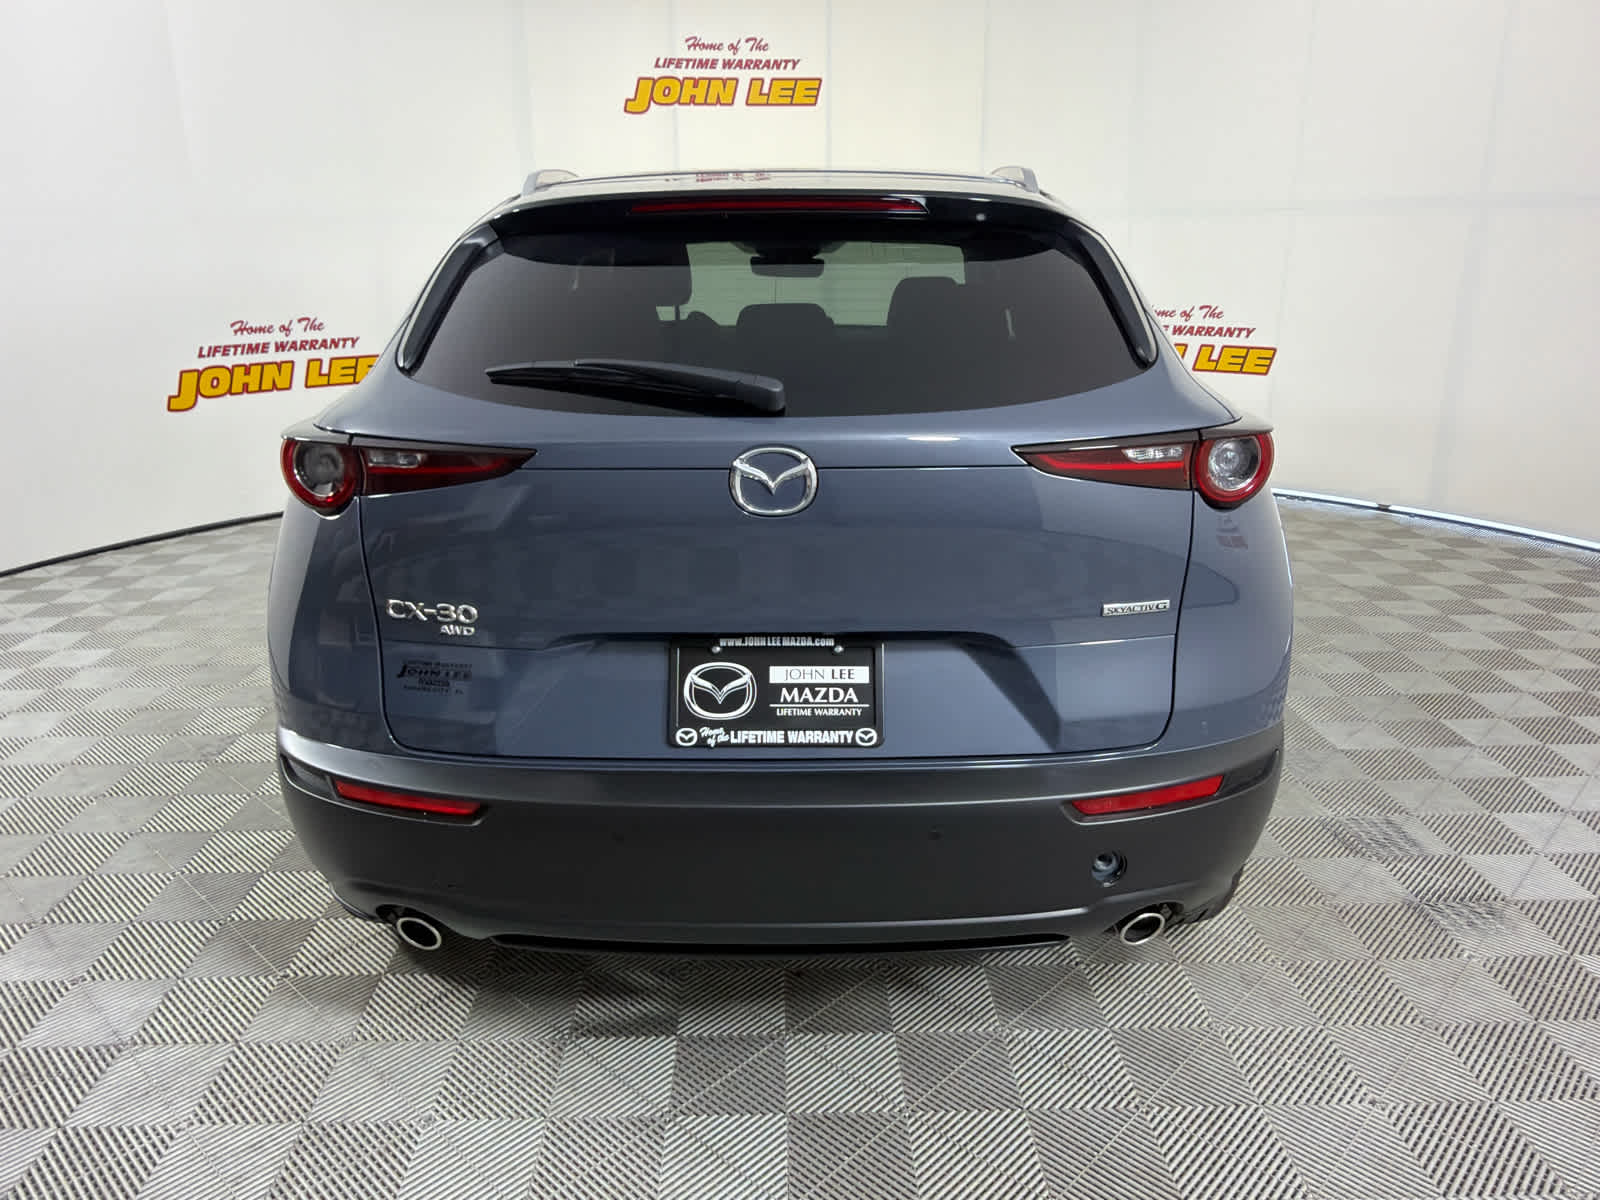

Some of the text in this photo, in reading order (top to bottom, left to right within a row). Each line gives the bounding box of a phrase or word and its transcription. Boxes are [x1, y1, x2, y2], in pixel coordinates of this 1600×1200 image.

[685, 36, 769, 55] Home of The
[654, 57, 800, 71] LIFETIME WARRANTY
[624, 76, 822, 114] JOHN LEE
[1180, 305, 1195, 321] of
[1199, 304, 1225, 319] The
[230, 316, 325, 336] Home of The
[1171, 324, 1256, 338] WARRANTY
[197, 336, 360, 358] LIFETIME WARRANTY
[1192, 344, 1277, 376] LEE
[167, 360, 295, 412] JOHN
[386, 599, 478, 624] CX-30
[440, 624, 475, 636] AWD
[784, 668, 856, 682] JOHN LEE
[780, 687, 859, 703] MAZDA
[776, 708, 863, 716] LIFETIME WARRANTY
[730, 730, 785, 744] LIFETIME
[787, 730, 854, 744] WARRANTY
